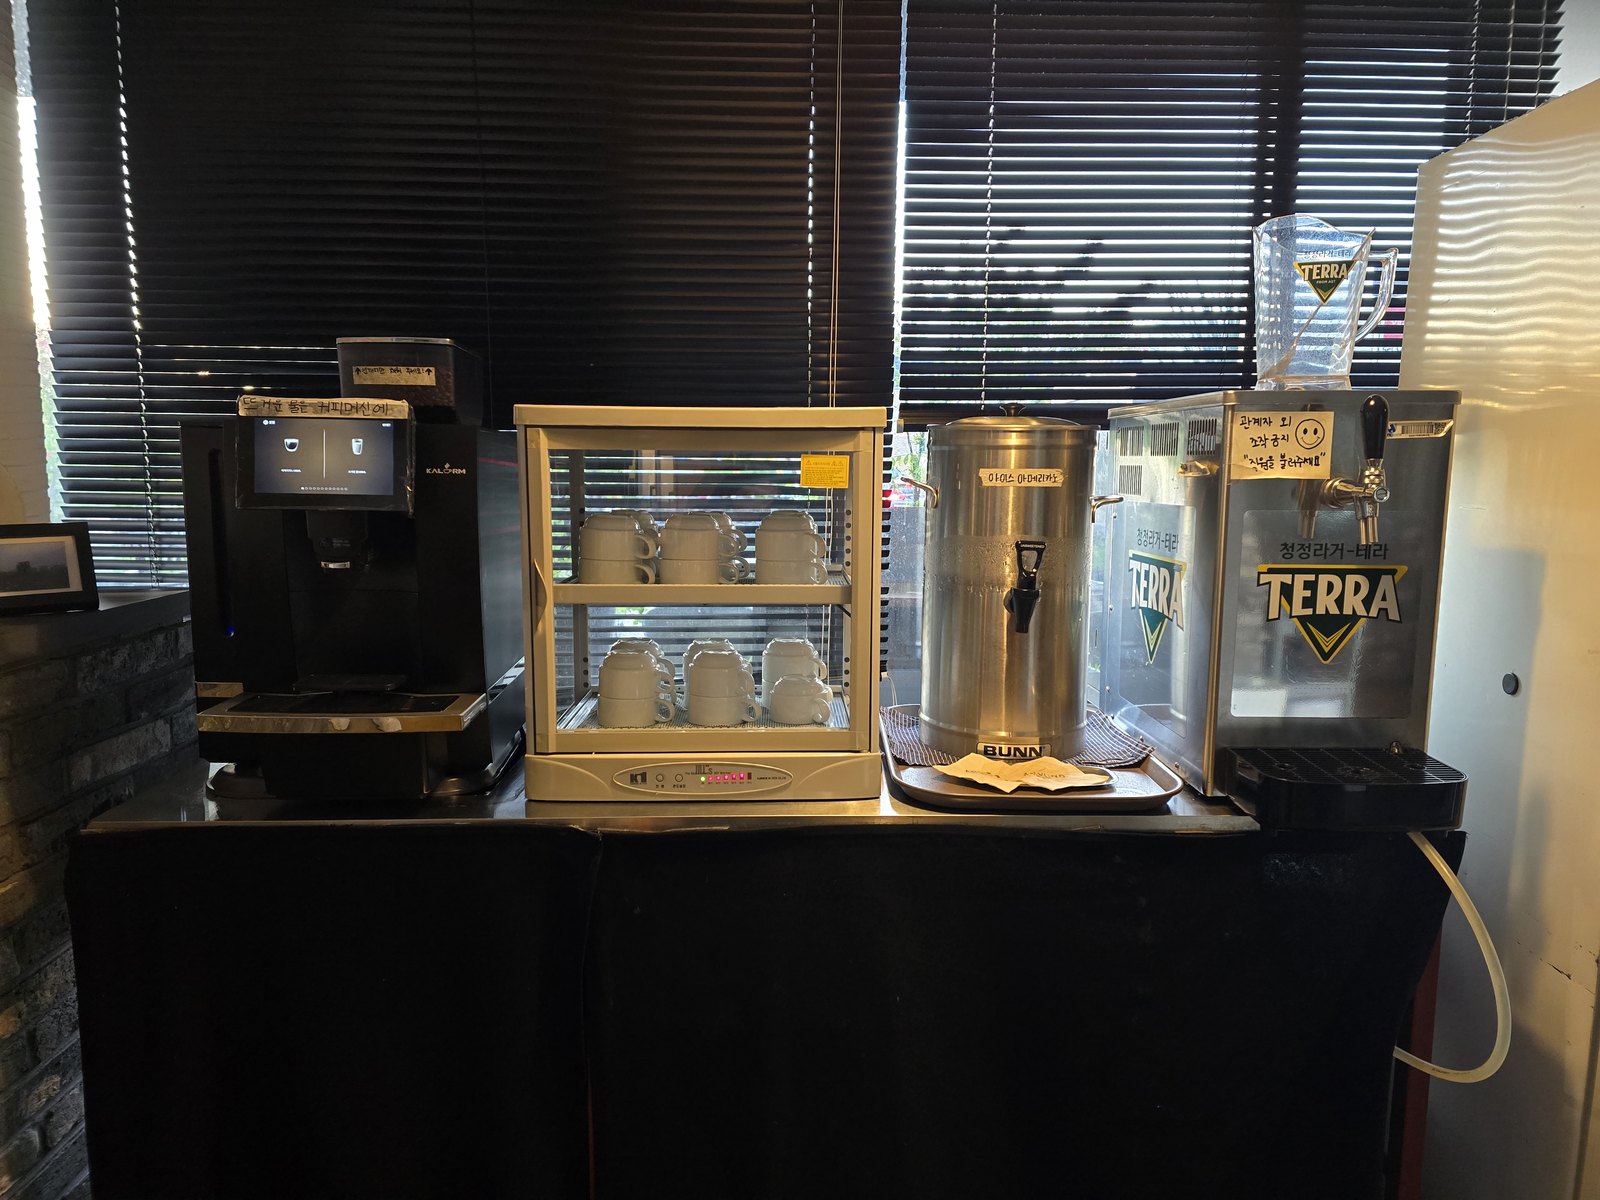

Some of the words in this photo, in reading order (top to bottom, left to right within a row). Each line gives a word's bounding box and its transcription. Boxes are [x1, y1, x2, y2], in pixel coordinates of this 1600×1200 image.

[1300, 263, 1349, 281] TERRA
[1239, 415, 1273, 430] 관계자
[1280, 415, 1292, 427] 외
[988, 472, 1015, 483] 아이스
[1017, 472, 1058, 483] 아메리카노
[1137, 528, 1180, 553] 청정라거-테라
[1279, 541, 1389, 561] 청정라거-테라
[1129, 560, 1185, 631] TERRA
[1257, 572, 1402, 622] TERRA
[983, 745, 1043, 758] BUNN
